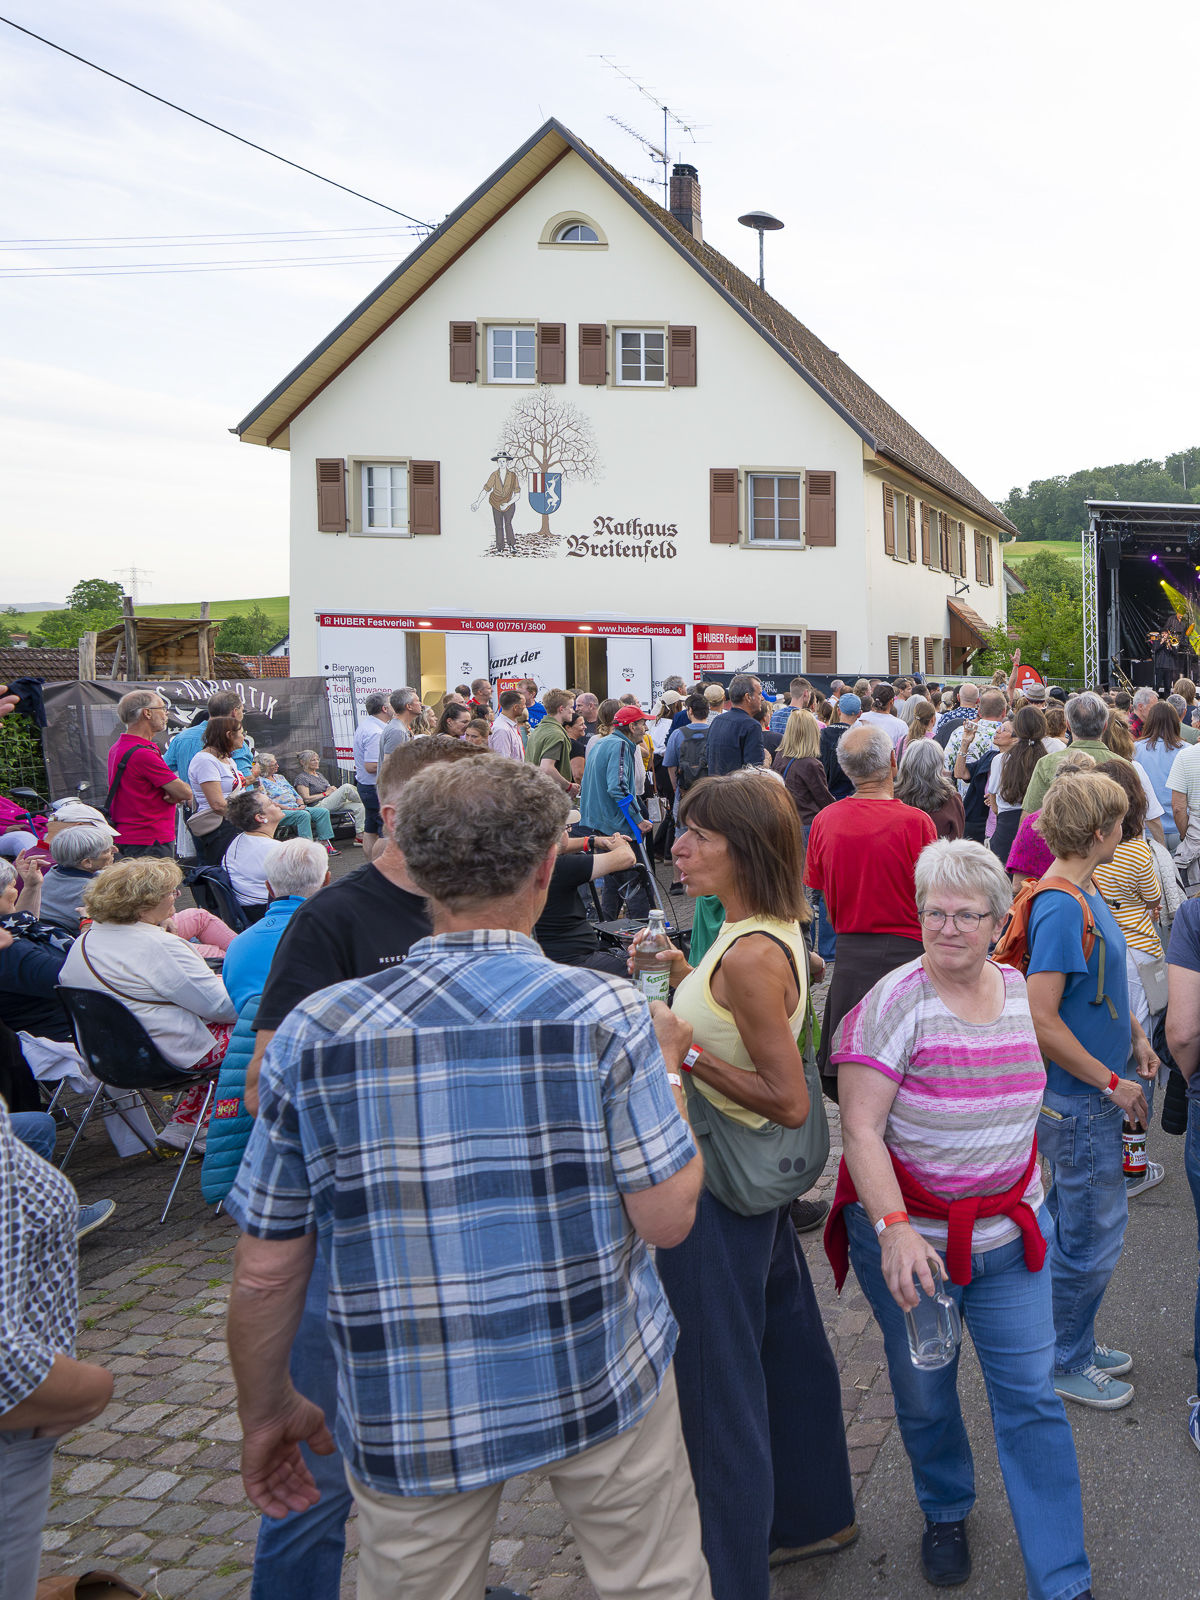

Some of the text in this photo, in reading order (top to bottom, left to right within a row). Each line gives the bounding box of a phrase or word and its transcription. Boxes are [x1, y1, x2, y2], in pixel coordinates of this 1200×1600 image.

[592, 515, 679, 540] Rathaus
[565, 534, 678, 563] Breitenfeld
[333, 617, 415, 627] HUBER Festverleih
[461, 621, 547, 632] Tel. 0049 (0)7761/3600
[597, 625, 682, 634] www.huber-dienste.de
[703, 632, 754, 644] HUBER Festverleih
[520, 650, 541, 664] der
[332, 663, 375, 674] Bierwagen
